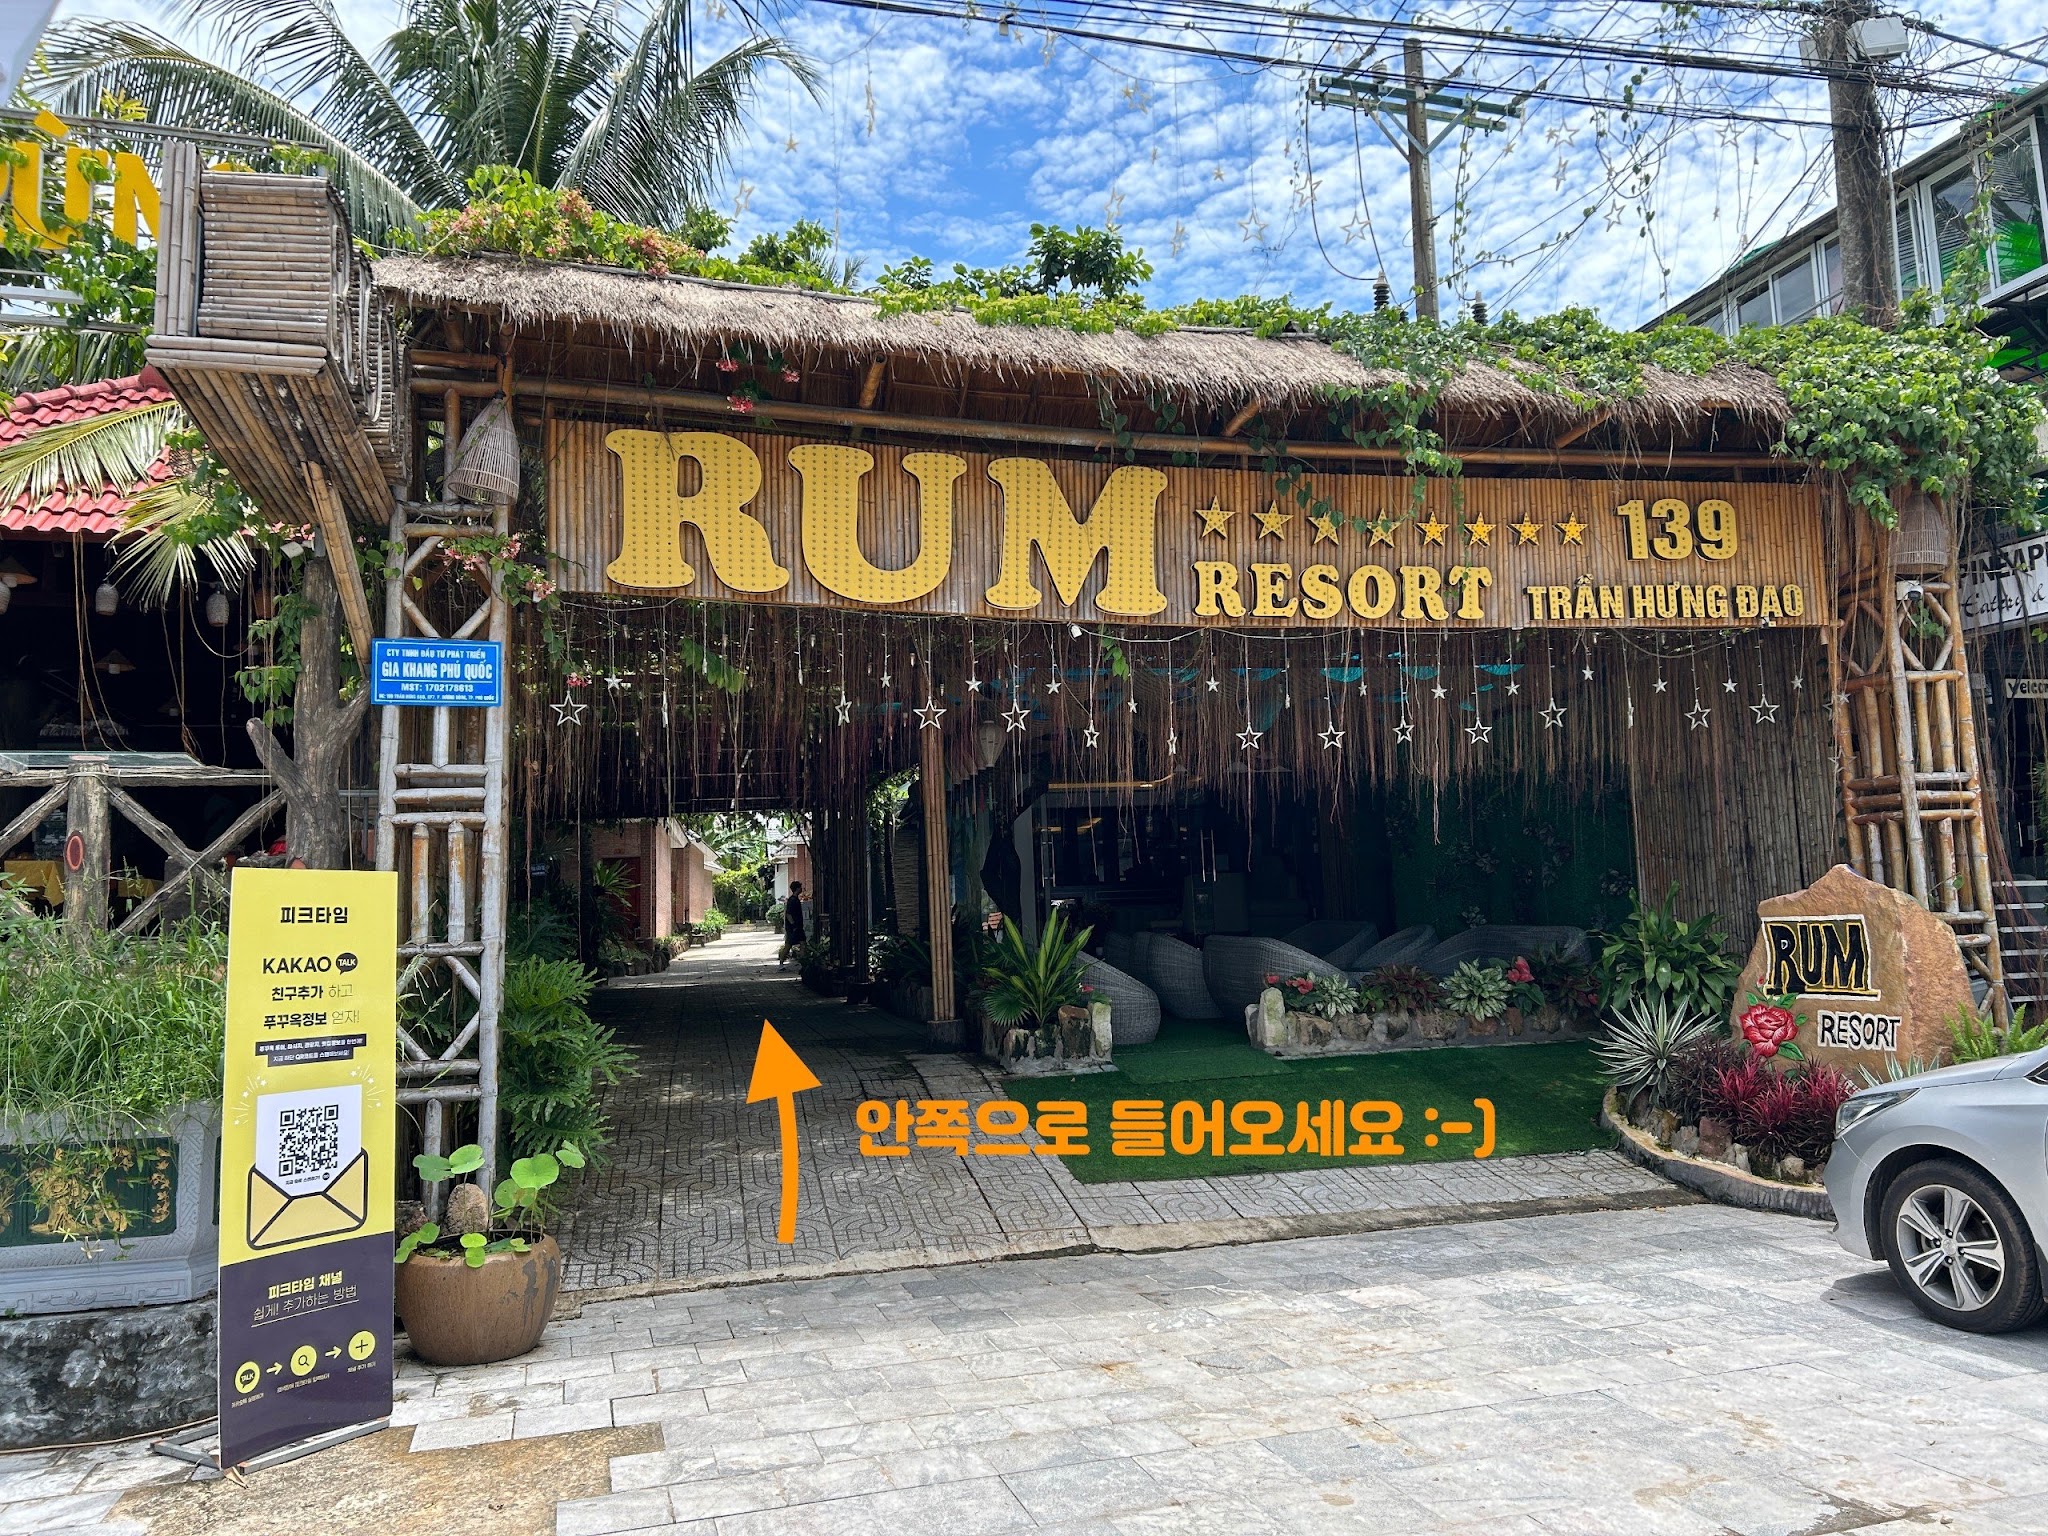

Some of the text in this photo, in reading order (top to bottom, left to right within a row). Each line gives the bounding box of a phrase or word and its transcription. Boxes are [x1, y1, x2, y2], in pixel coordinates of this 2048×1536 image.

[605, 429, 1168, 615] RUM
[1615, 498, 1738, 561] 139
[1959, 542, 2048, 589] PINEAP
[1195, 561, 1492, 621] RESORT
[1632, 581, 1730, 619] HƯNG
[386, 649, 400, 657] CTY
[382, 659, 493, 681] GIA KHANG PHÚ QUỐC
[401, 683, 422, 692] MST:
[2008, 680, 2048, 696] elco
[280, 906, 348, 924] 피크타임
[262, 956, 357, 974] KAKAO TALK
[1766, 922, 1870, 995] RUM
[271, 984, 353, 1002] 친구추가 하고
[263, 1012, 327, 1030] 푸꾸옥정보
[1820, 1013, 1901, 1048] RESORT
[268, 1270, 343, 1300] 피크타임 채널
[283, 1292, 330, 1314] 추가하는
[333, 1284, 358, 1302] 방법
